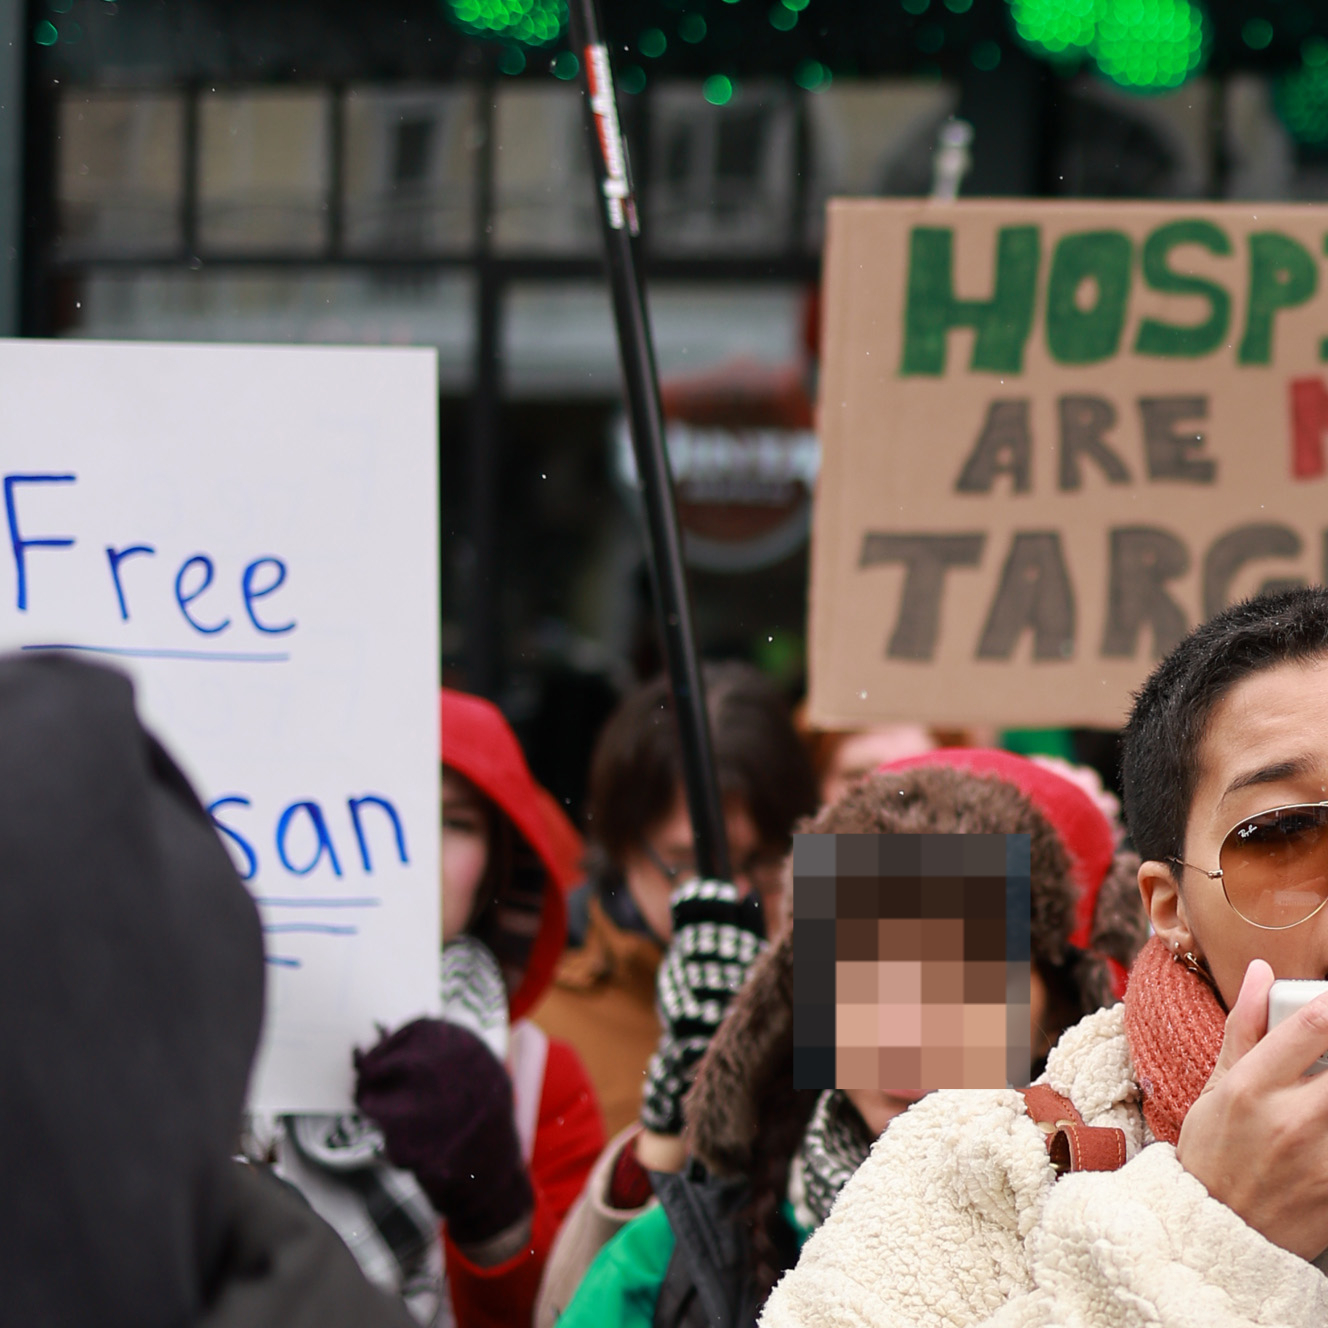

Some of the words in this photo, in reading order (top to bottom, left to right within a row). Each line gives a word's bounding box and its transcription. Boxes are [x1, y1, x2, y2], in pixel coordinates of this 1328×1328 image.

[953, 393, 1218, 494] ARE
[2, 473, 298, 636] Free
[207, 796, 409, 880] san
